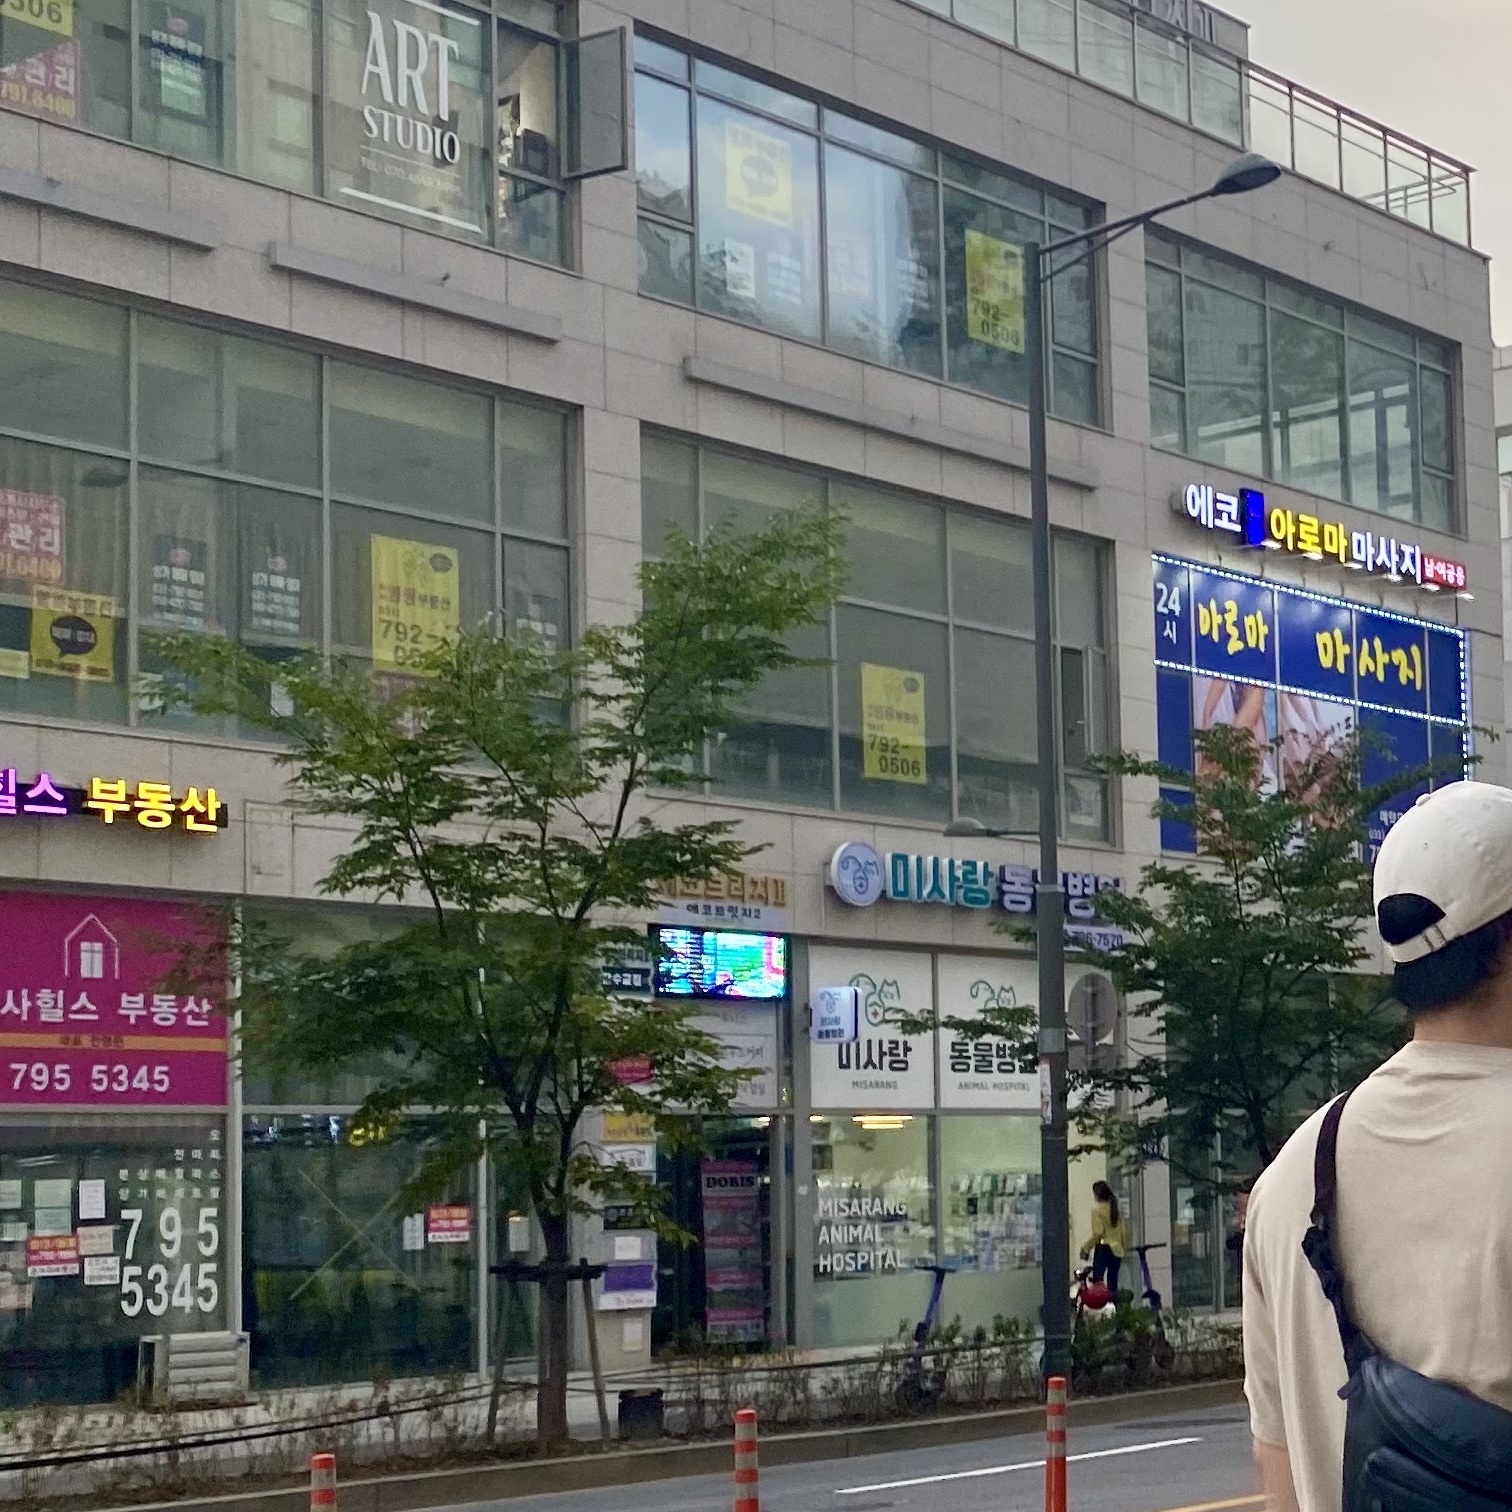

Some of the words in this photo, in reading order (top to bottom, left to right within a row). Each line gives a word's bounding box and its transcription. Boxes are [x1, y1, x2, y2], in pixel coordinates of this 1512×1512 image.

[361, 10, 459, 122] ART
[363, 104, 460, 165] STUDIO
[1185, 483, 1242, 532] 에코
[1270, 508, 1348, 563] 아로마
[1352, 530, 1423, 585] 마사지
[1156, 583, 1182, 617] 24
[1163, 620, 1178, 646] 시
[1198, 598, 1270, 656] 아로마
[1315, 627, 1423, 692] 마사지
[878, 755, 921, 777] 0506
[87, 777, 221, 833] 부동산
[886, 852, 994, 911] 미사랑
[0, 988, 99, 1023] 사힐스
[117, 991, 211, 1027] 부동산
[837, 1039, 912, 1072] 미사랑
[9, 1062, 71, 1092] 795
[91, 1063, 170, 1093] 5345
[706, 1174, 755, 1189] DORIS
[817, 1197, 907, 1218] MISARANG
[120, 1206, 219, 1260] 795
[817, 1224, 885, 1245] ANIMAL
[818, 1249, 904, 1274] HOSPITAL
[120, 1262, 219, 1318] 5345
